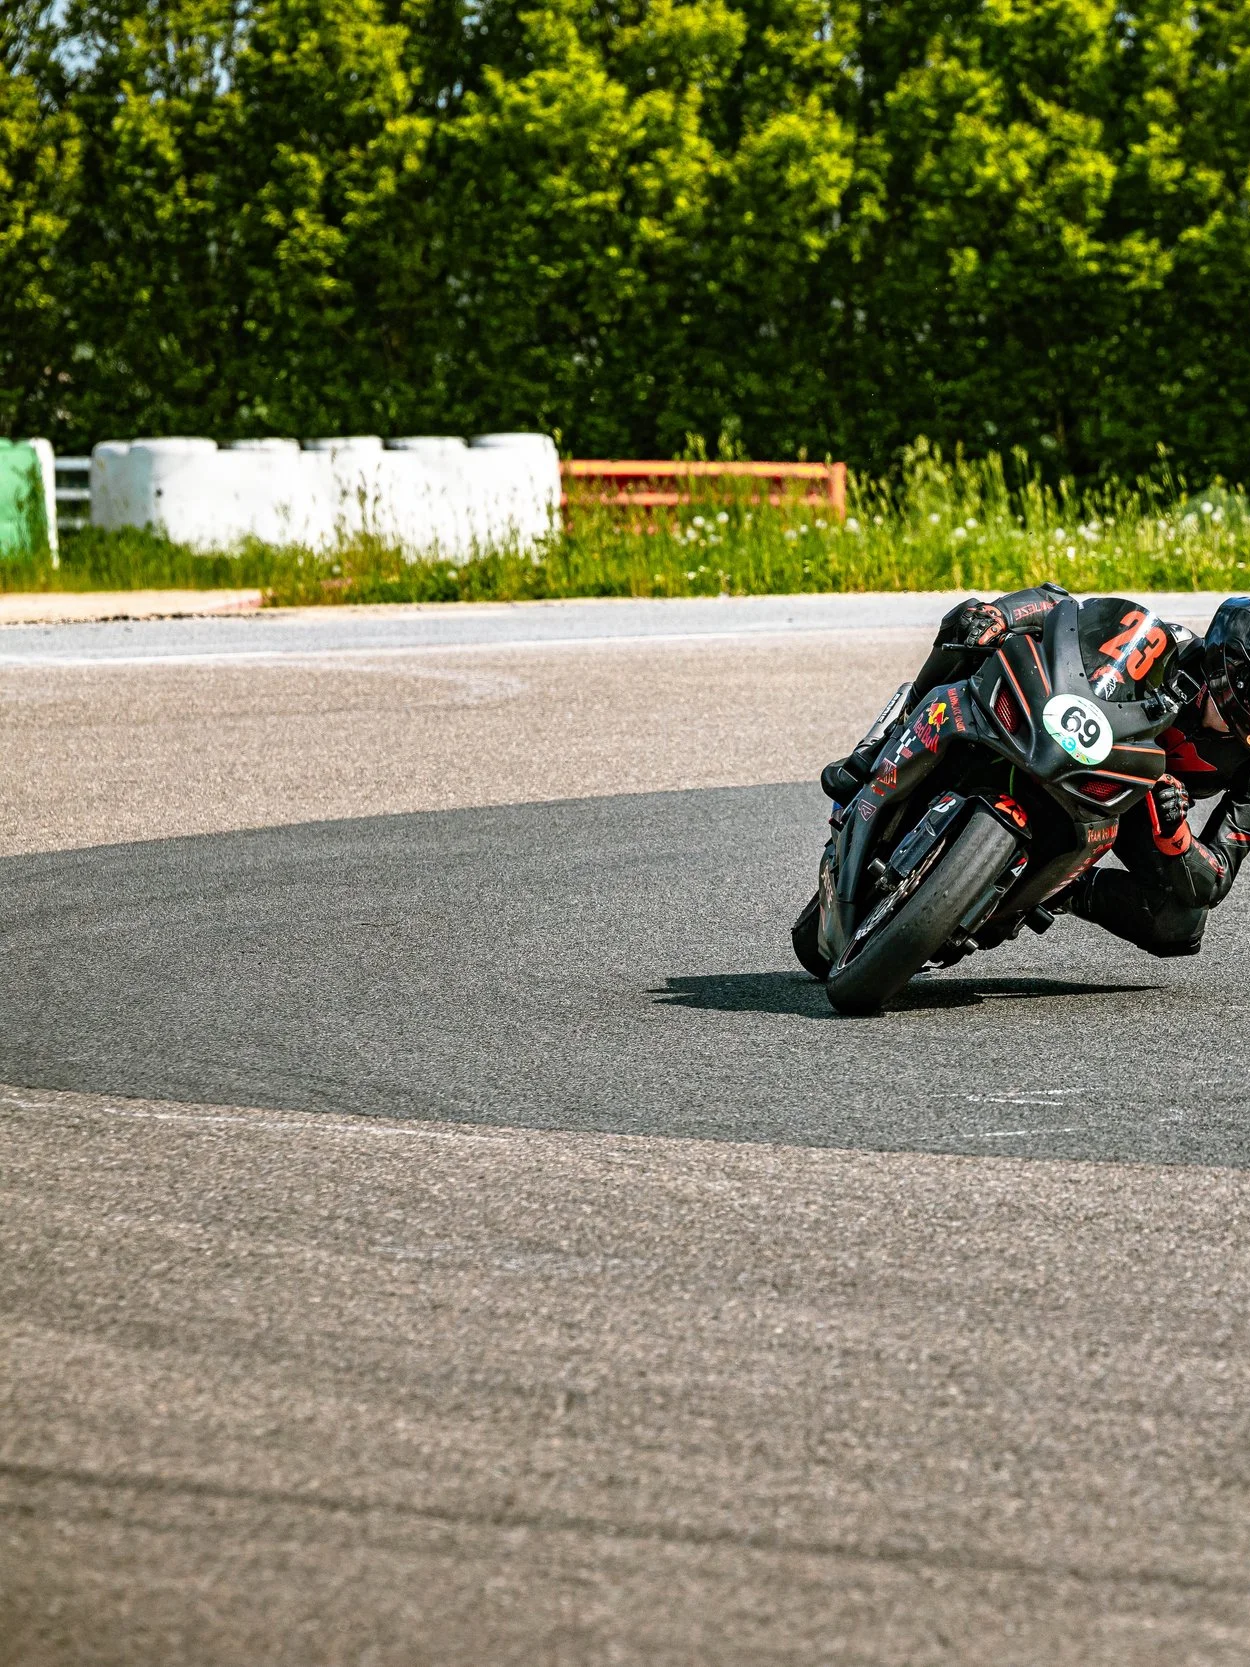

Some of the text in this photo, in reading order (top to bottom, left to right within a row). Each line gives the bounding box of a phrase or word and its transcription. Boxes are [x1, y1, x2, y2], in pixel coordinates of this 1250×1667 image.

[1098, 610, 1168, 681] 23
[1060, 706, 1101, 749] 69
[994, 794, 1028, 828] 23
